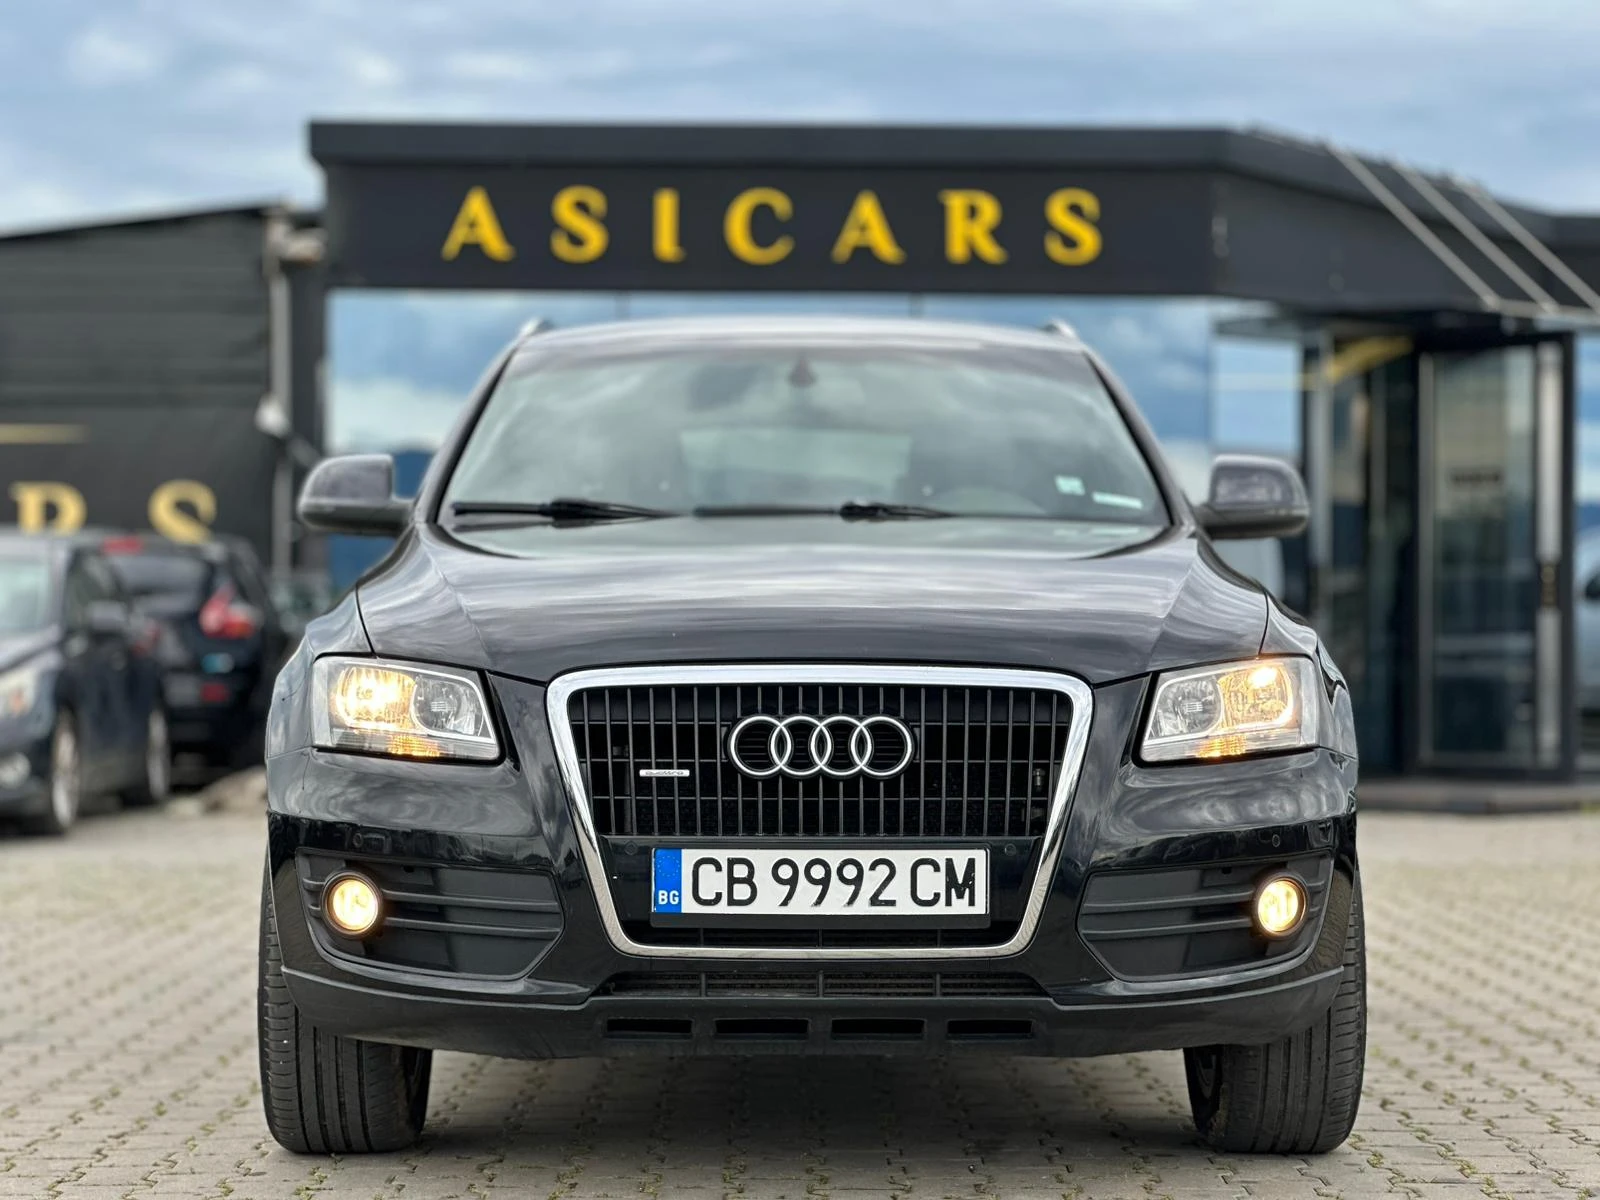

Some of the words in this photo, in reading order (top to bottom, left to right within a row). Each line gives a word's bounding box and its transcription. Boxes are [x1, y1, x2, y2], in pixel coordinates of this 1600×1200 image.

[442, 186, 1102, 265] ASICARS
[658, 890, 679, 905] BG
[691, 857, 758, 906] CB
[771, 857, 897, 907] 9992
[910, 857, 976, 907] CM
